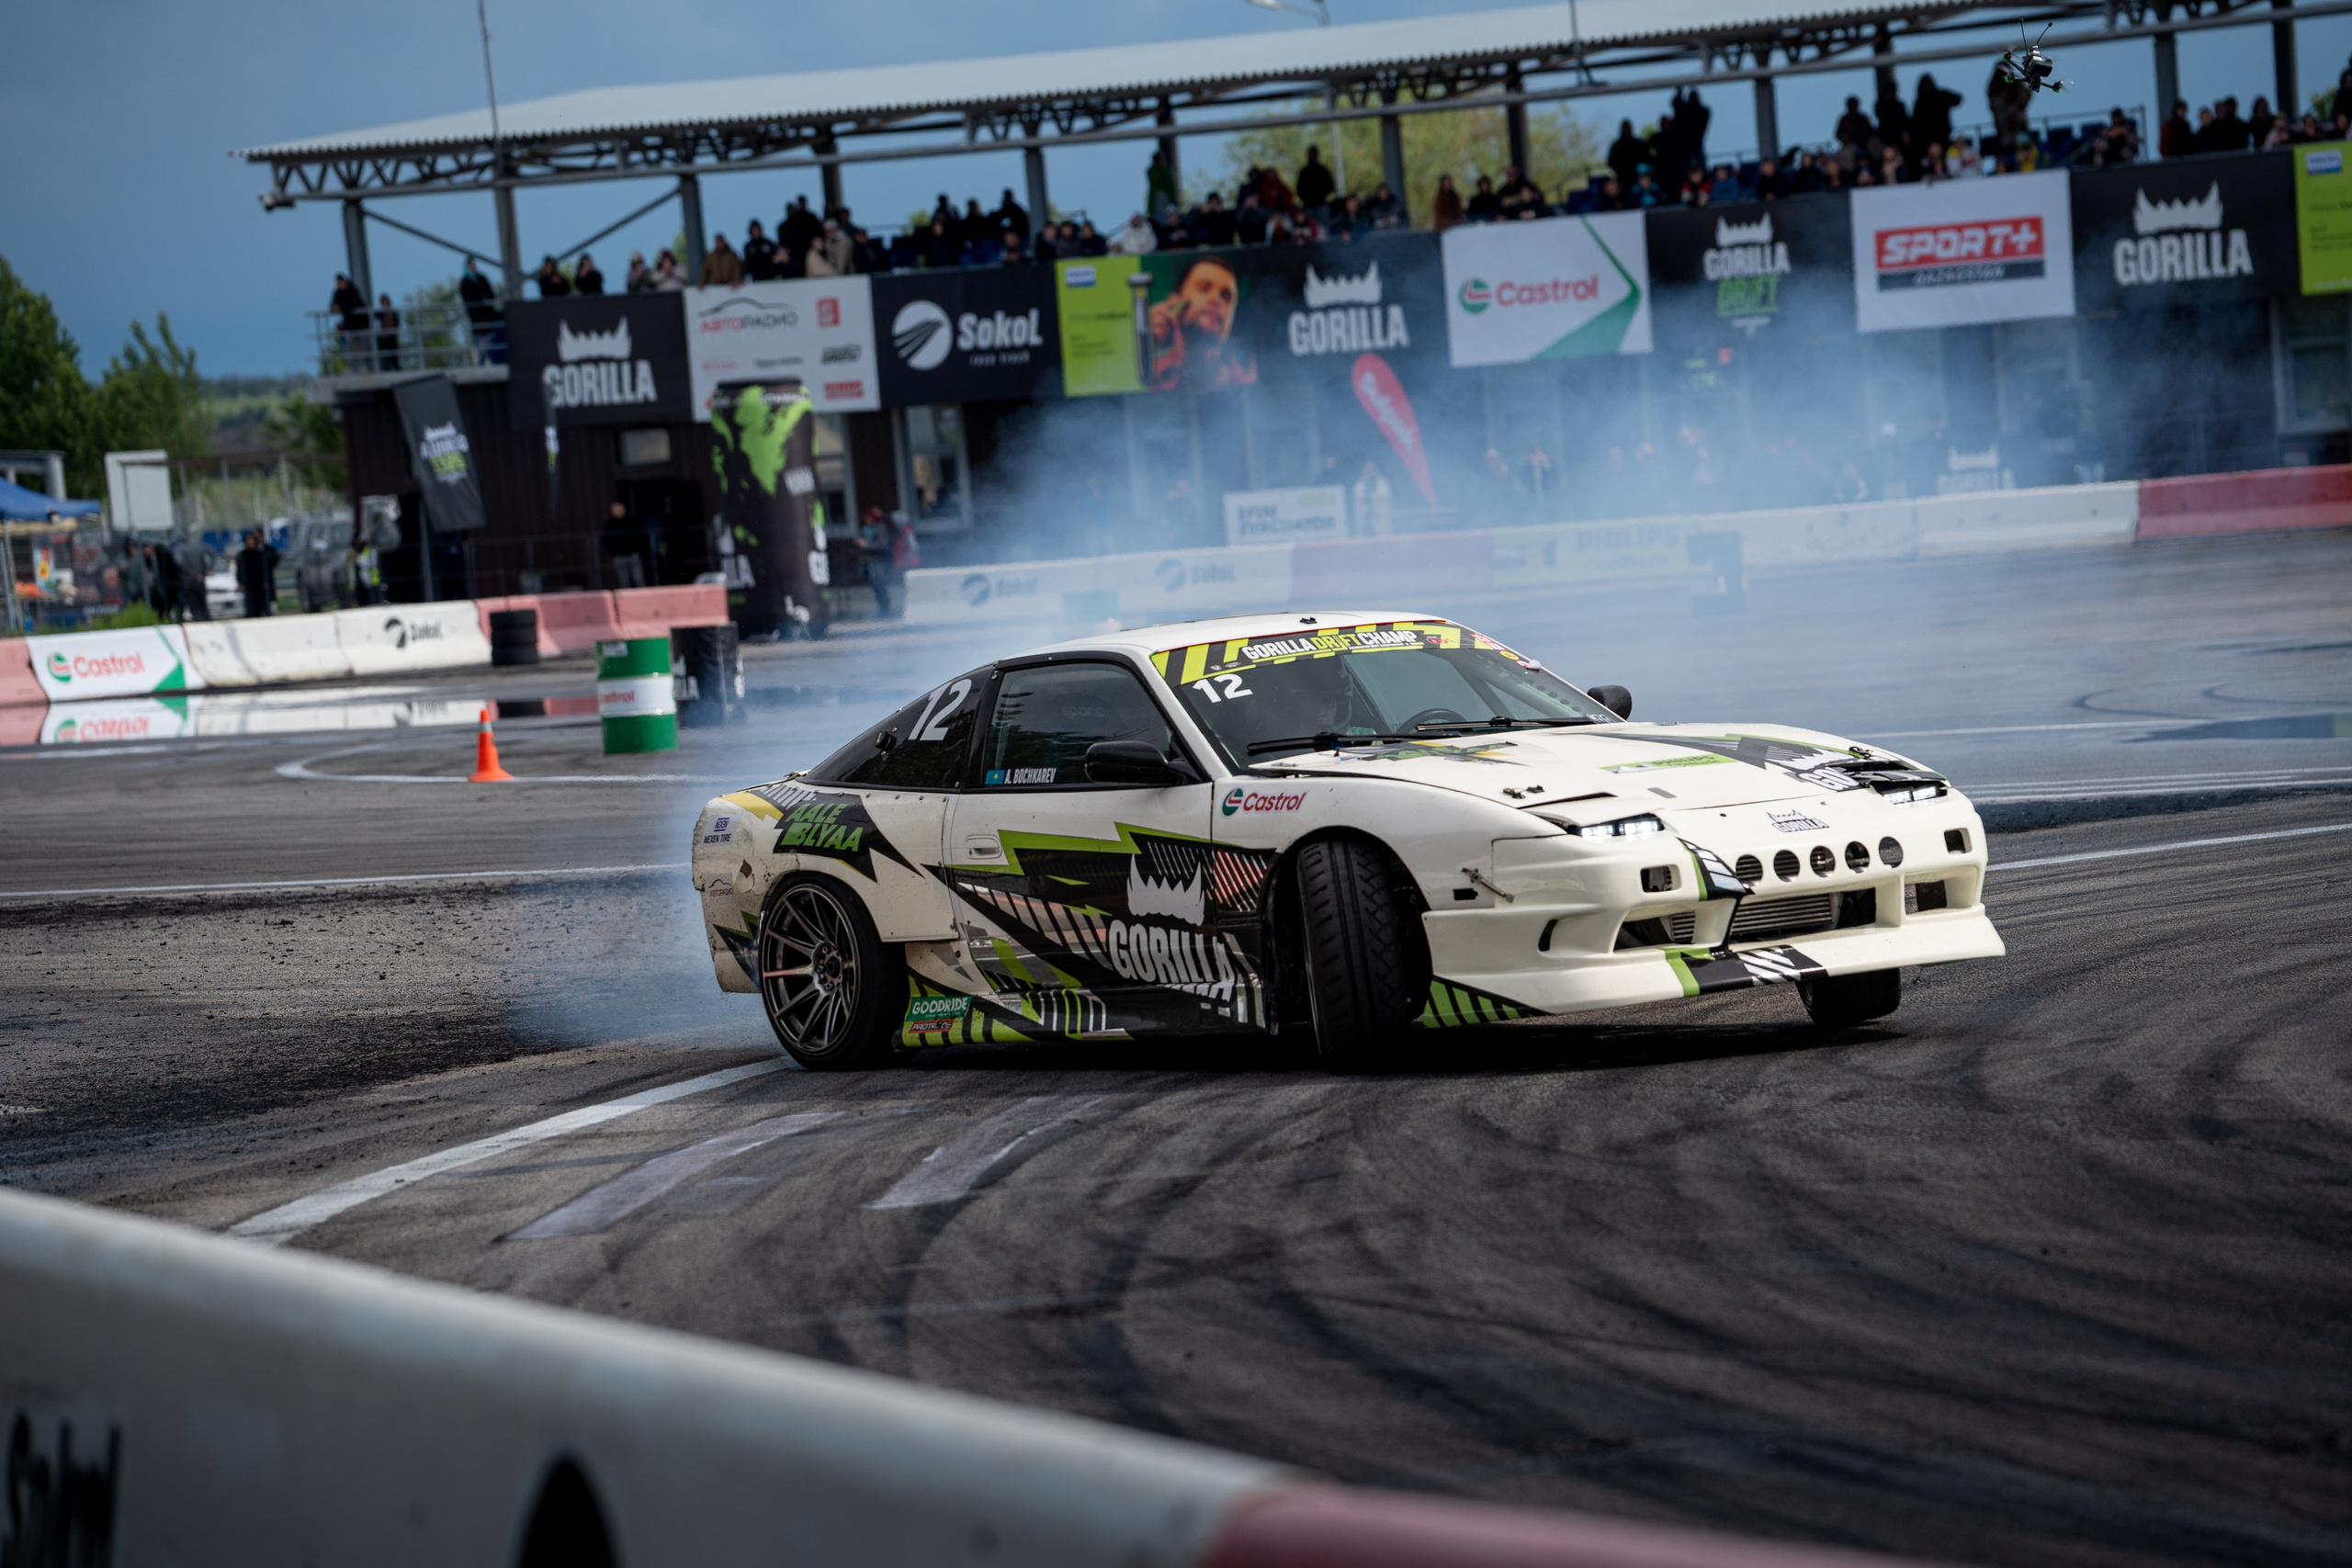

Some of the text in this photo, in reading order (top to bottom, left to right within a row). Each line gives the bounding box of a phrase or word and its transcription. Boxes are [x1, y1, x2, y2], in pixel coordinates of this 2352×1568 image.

[1881, 222, 2038, 265] SPORT+
[2113, 229, 2254, 286] GORILLA
[1702, 242, 1792, 281] GORILLA
[1496, 275, 1599, 307] Castrol
[1289, 304, 1410, 356] GORILLA
[542, 359, 658, 408] GORILLA
[74, 651, 145, 679] Castrol
[1193, 672, 1253, 704] 12
[908, 679, 972, 740] 12
[1004, 768, 1057, 784] A. BOCHKAREV
[784, 803, 849, 824] AALE
[1243, 792, 1306, 811] Castrol
[704, 833, 732, 843] NEXEN TIRE
[781, 822, 864, 852] BLYAA
[1773, 818, 1830, 832] GORILLA
[1109, 919, 1235, 1002] GORILLA
[912, 997, 968, 1014] GOODRIDE
